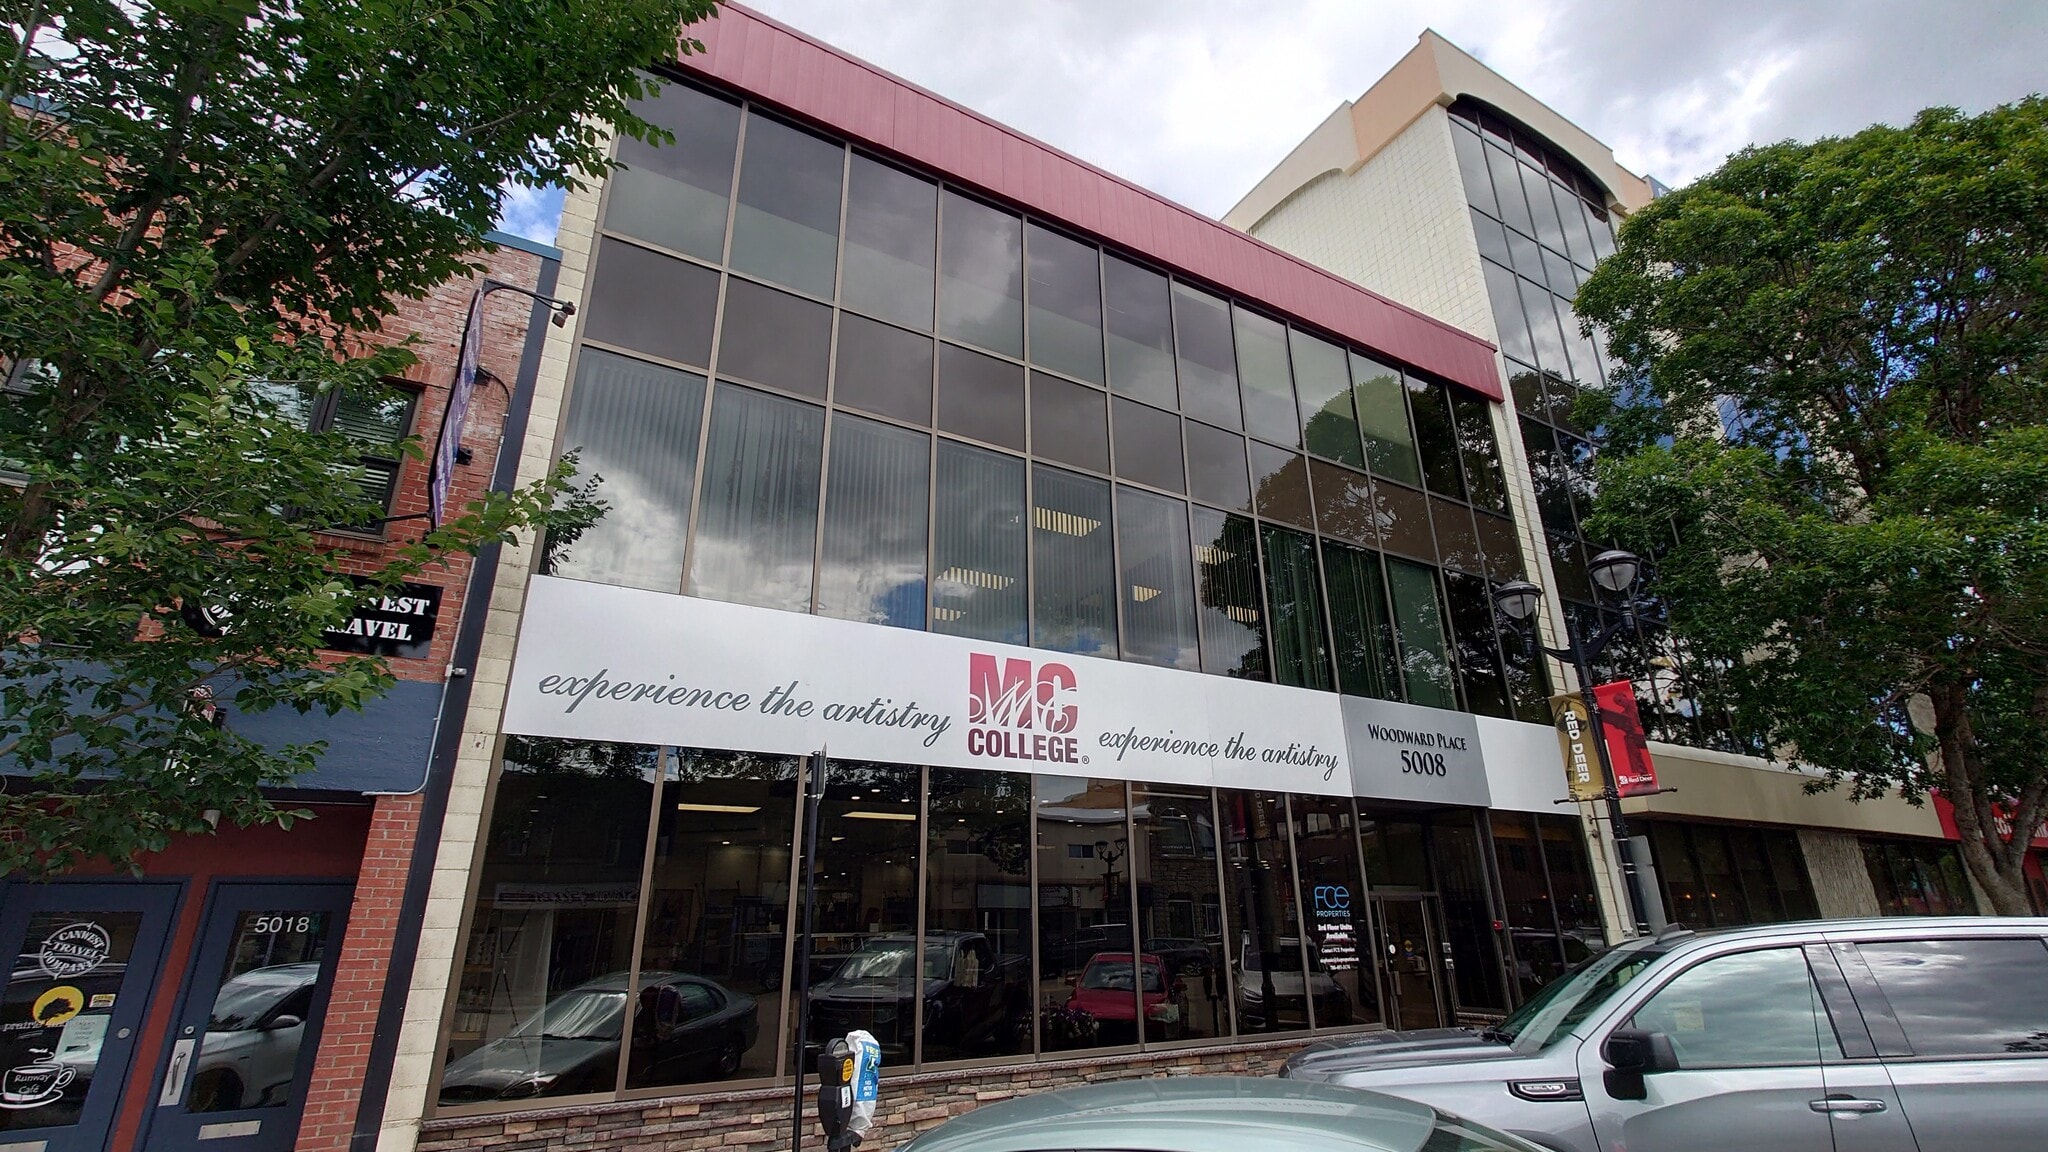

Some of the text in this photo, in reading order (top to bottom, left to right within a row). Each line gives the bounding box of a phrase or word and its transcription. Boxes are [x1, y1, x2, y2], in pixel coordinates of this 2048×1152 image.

[325, 617, 412, 641] AVEL
[969, 651, 1079, 735] MC
[538, 668, 952, 748] experience the artistry
[967, 727, 1079, 764] COLLEGE
[1367, 723, 1468, 751] WOODWARD PLACE
[1564, 710, 1590, 783] RED DEER
[1099, 726, 1339, 781] experience the artistry
[1400, 749, 1447, 777] 5008
[254, 916, 310, 933] 5018
[1316, 909, 1351, 918] PROPERTIES
[53, 941, 99, 959] TRAVEL
[58, 930, 105, 948] CANWEST
[43, 950, 94, 972] COMPANY
[14, 1073, 52, 1083] Runway
